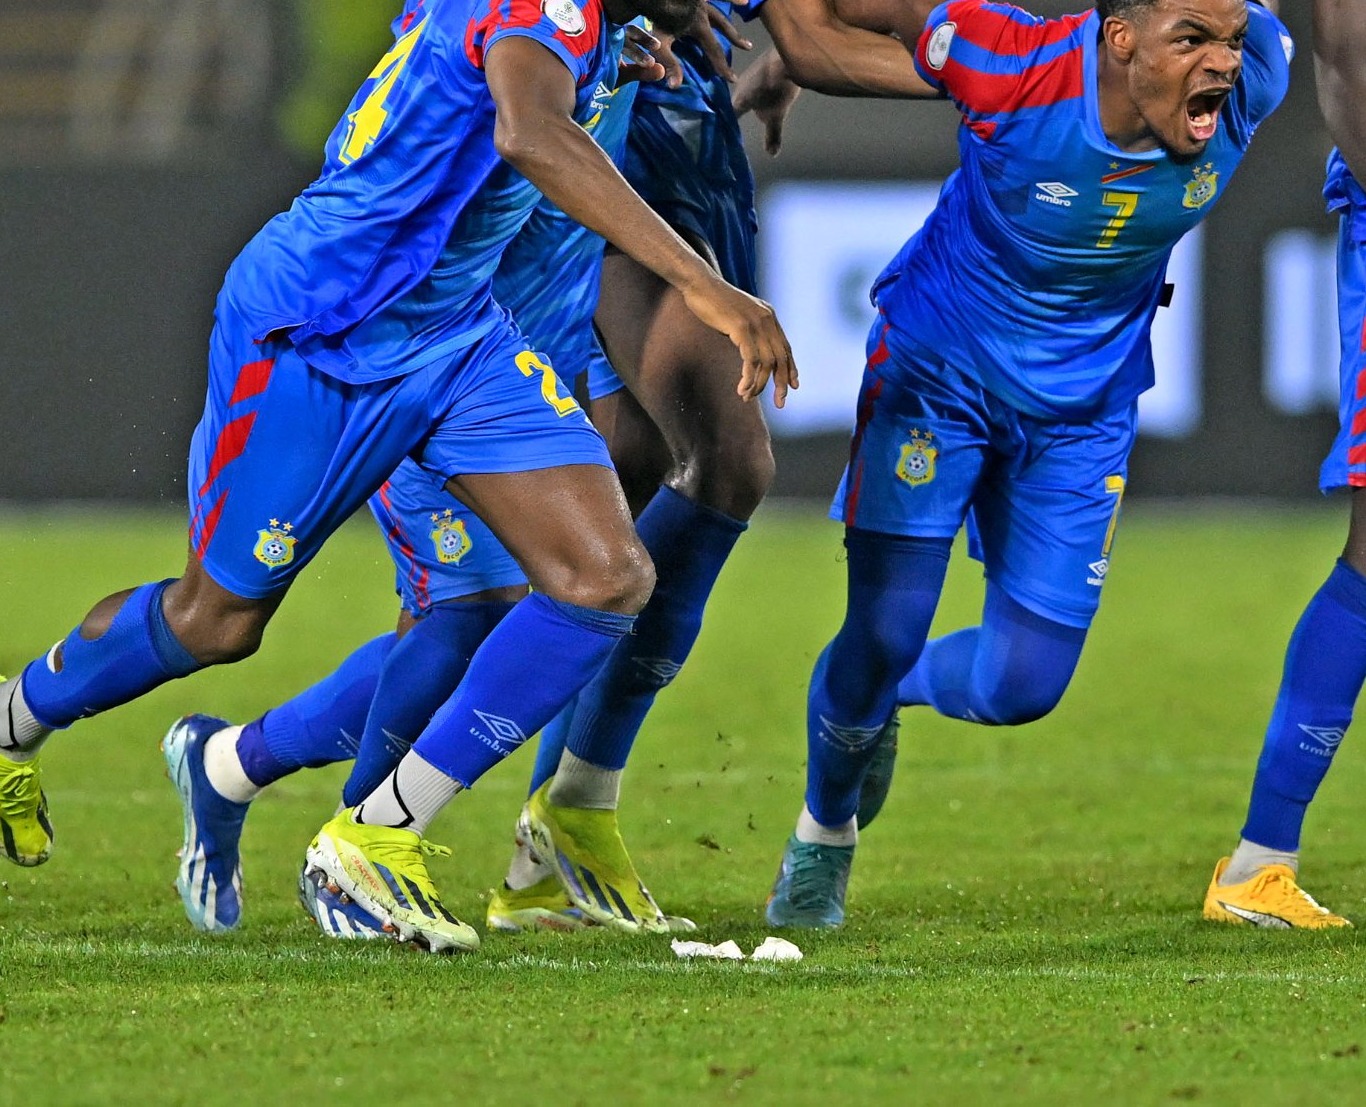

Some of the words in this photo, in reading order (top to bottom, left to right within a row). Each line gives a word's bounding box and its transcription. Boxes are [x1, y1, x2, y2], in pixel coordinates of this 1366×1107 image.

[1035, 193, 1071, 207] umbro
[1096, 192, 1139, 248] 7
[1102, 475, 1125, 558] 7
